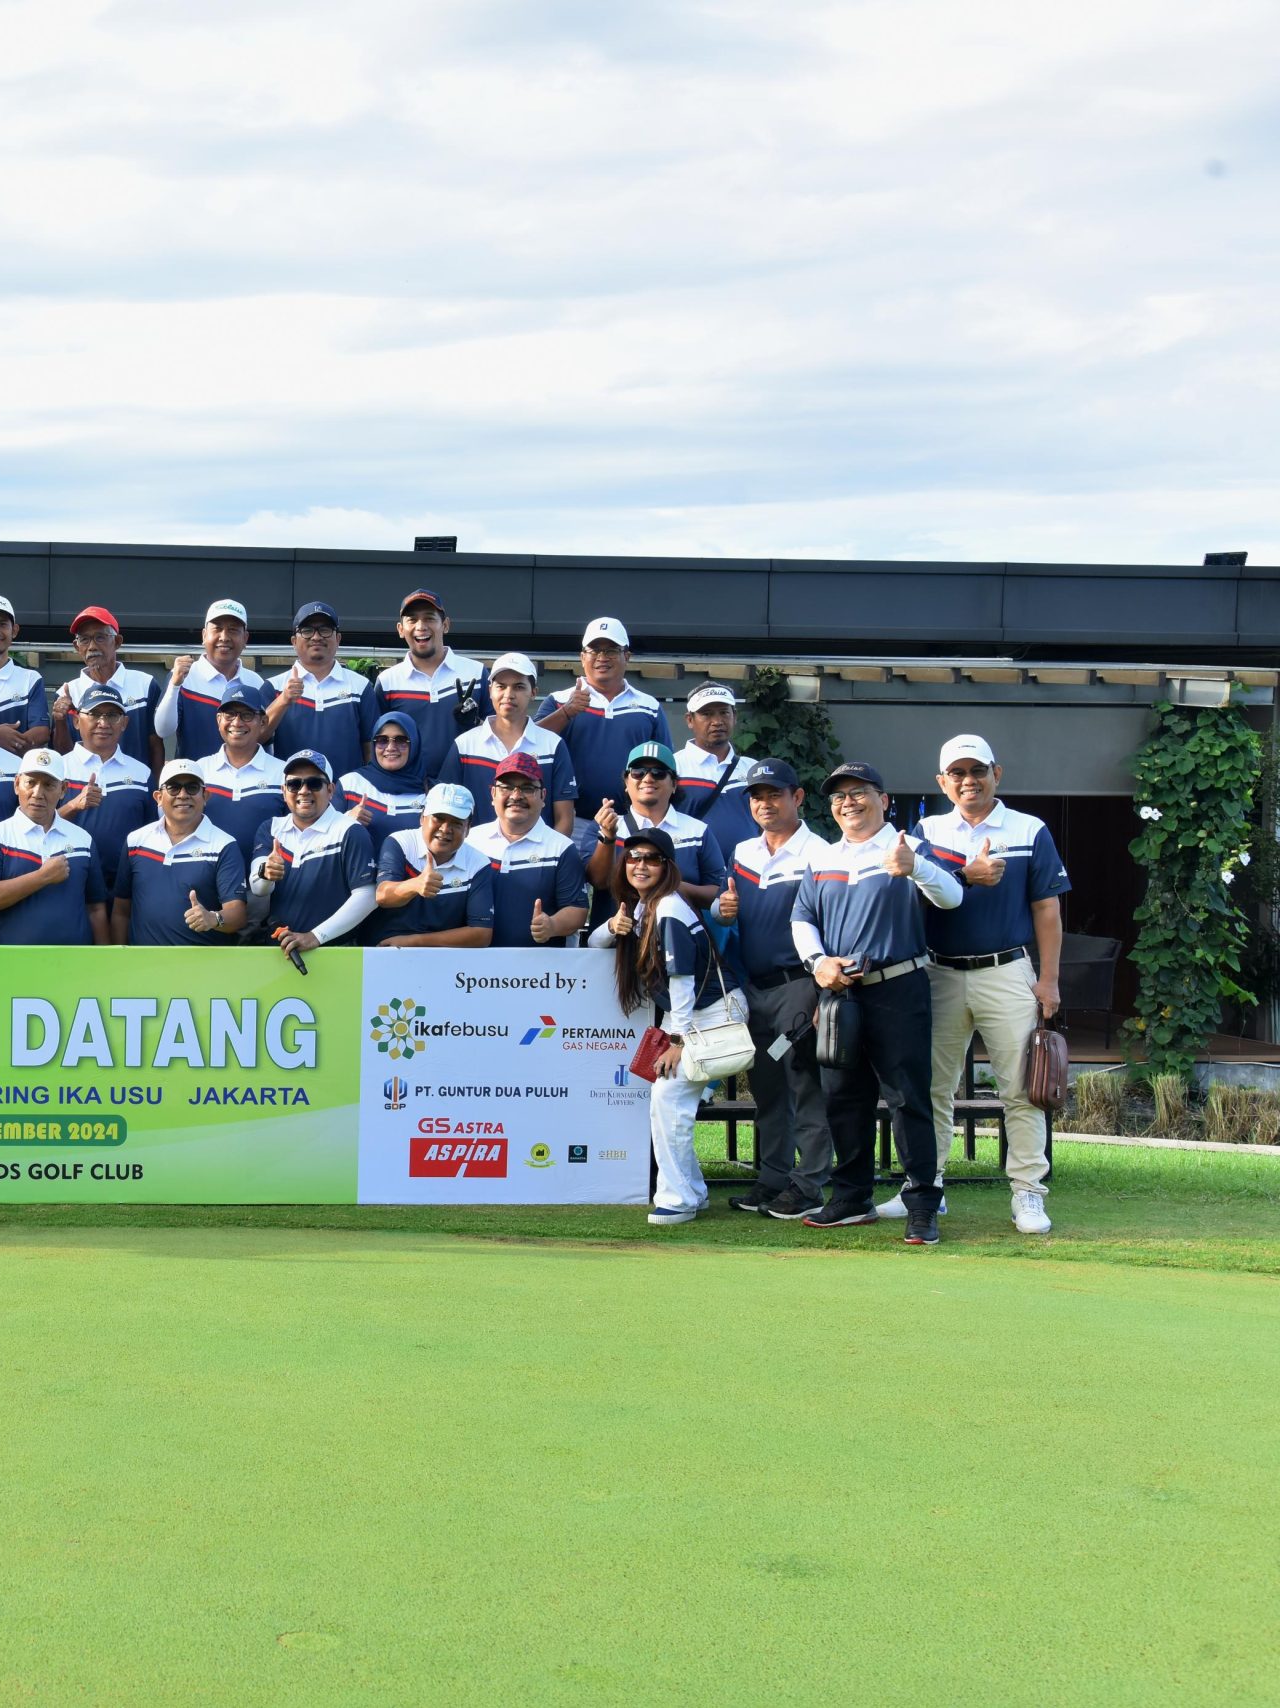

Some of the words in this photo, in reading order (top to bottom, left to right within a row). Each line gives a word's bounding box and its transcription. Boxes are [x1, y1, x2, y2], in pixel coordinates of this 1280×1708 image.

[455, 972, 551, 993] Sponsored
[555, 973, 577, 993] by
[10, 996, 318, 1069] DATANG
[414, 1021, 509, 1037] ikafebusu
[562, 1028, 635, 1039] PERTAMINA
[562, 1041, 583, 1050] GAS
[586, 1041, 627, 1050] NEGARA
[59, 1086, 102, 1105] IKA
[110, 1086, 163, 1106] USU
[188, 1087, 310, 1106] JAKARTA
[415, 1086, 434, 1098] PT.
[438, 1086, 491, 1098] GUNTUR
[495, 1087, 521, 1098] DUA
[526, 1086, 568, 1098] PULUH
[67, 1122, 118, 1140] 2024
[418, 1117, 450, 1134] GS
[453, 1122, 504, 1134] ASTRA
[28, 1163, 83, 1181] GOLF
[90, 1164, 143, 1181] CLUB
